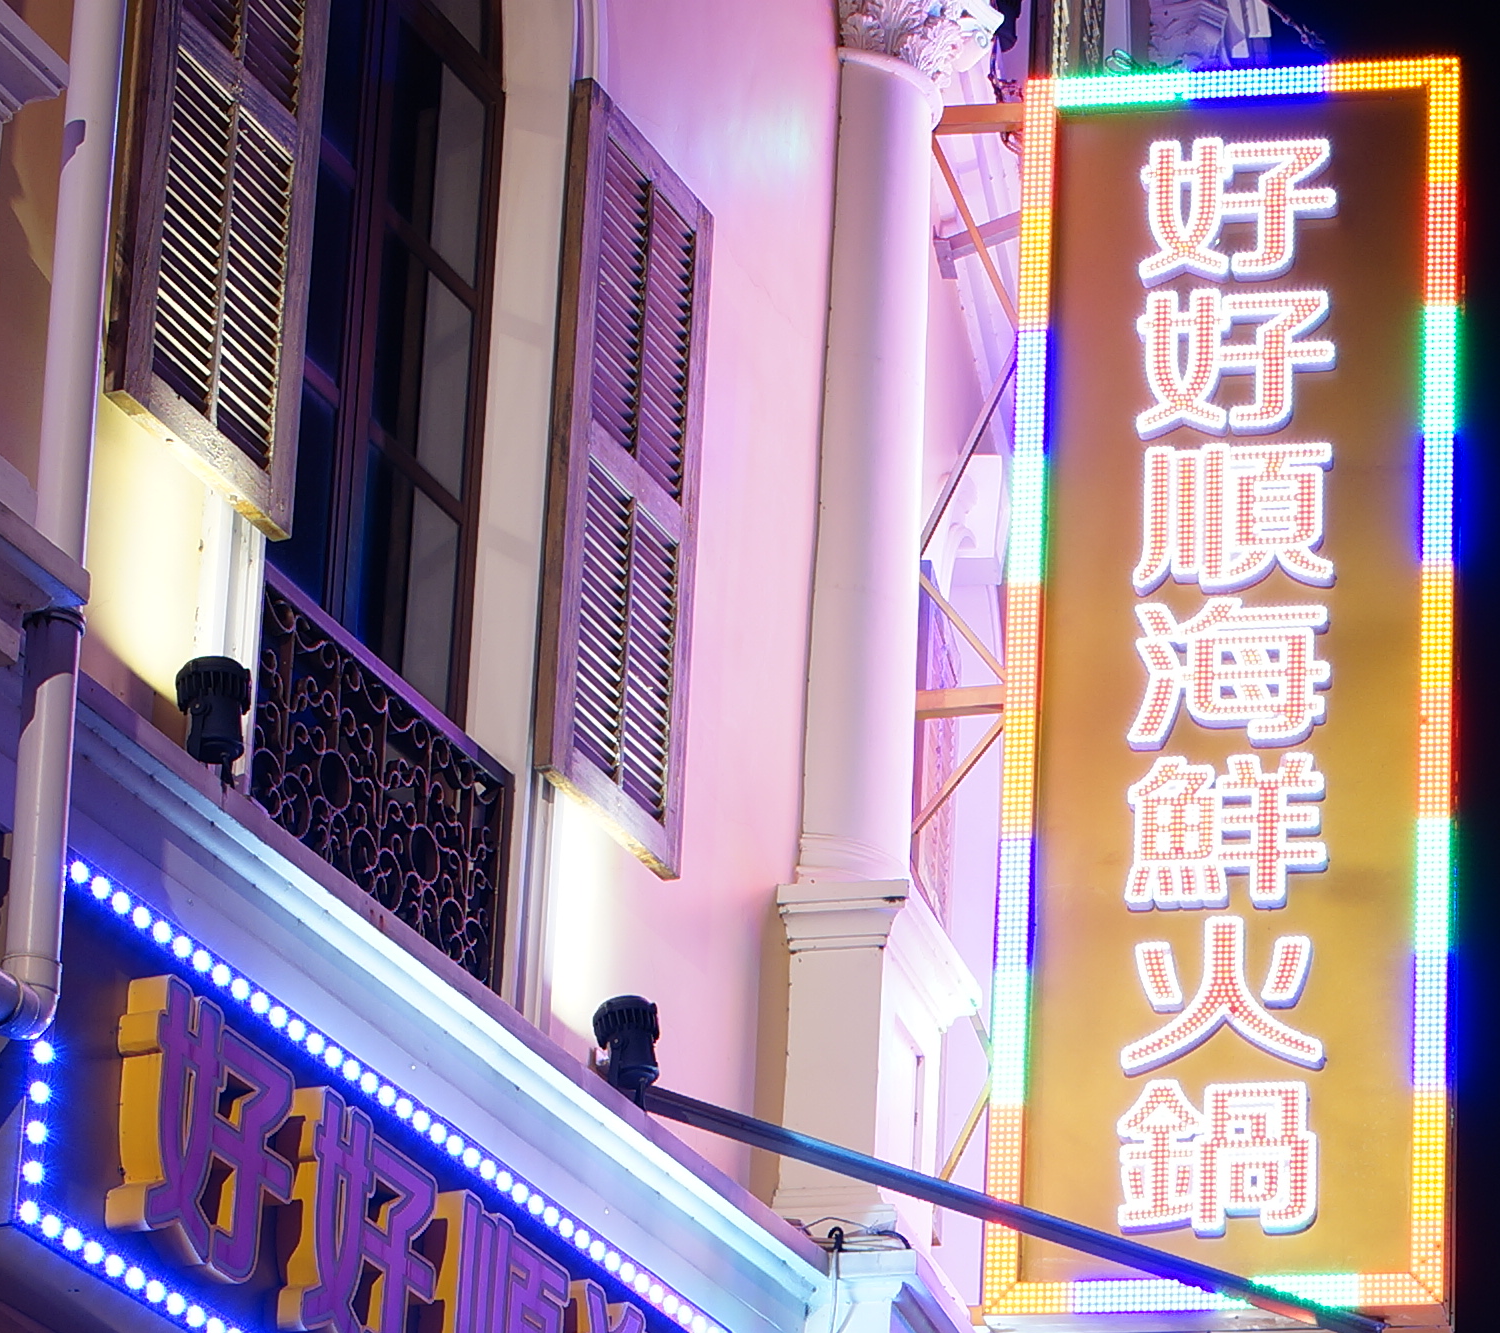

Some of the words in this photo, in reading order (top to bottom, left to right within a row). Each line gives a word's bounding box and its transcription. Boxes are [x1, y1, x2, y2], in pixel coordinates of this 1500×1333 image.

[1116, 136, 1338, 1238] 好好順海鮮火鍋
